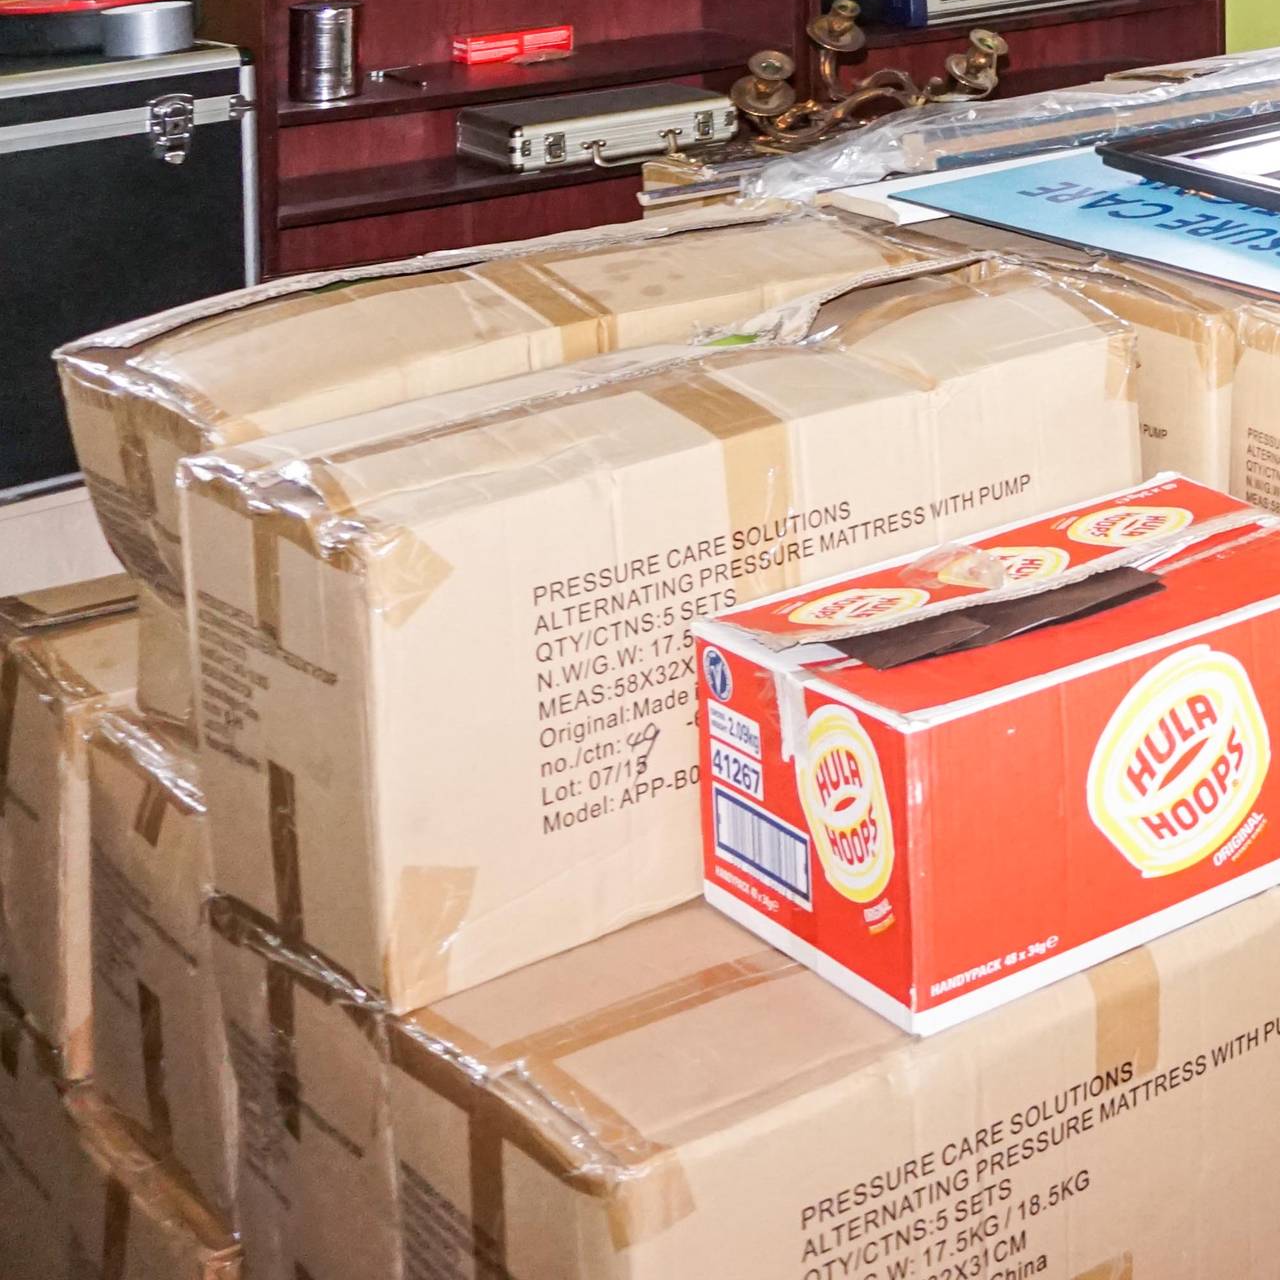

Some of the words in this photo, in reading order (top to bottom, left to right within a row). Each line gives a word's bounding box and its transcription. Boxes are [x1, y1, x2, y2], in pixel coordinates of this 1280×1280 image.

[1017, 182, 1173, 219] CARE
[533, 554, 662, 608] PRESSURE
[666, 536, 727, 572] CARE
[732, 500, 852, 552] SOLUTIONS
[534, 575, 694, 636] ALTERNATING
[700, 537, 814, 585] PRESSURE
[819, 504, 926, 555] MATTRESS
[930, 493, 974, 521] WITH
[978, 473, 1032, 507] PUMP
[535, 608, 676, 663] QTY/CTNS:5
[681, 589, 738, 622] SETS
[537, 645, 643, 692] N.W/G.W:
[652, 629, 694, 657] 17.5
[539, 656, 695, 721] MEAS:58X32X
[540, 689, 689, 748] Original:Made
[1126, 694, 1218, 797] HULA
[543, 796, 614, 834] Model:
[619, 765, 700, 809] APP-B0
[713, 749, 760, 794] 41267
[816, 749, 863, 807] HULA
[1141, 725, 1244, 840] HOOPS
[824, 801, 878, 865] HOOPS
[1212, 811, 1264, 866] ORIGINAL
[930, 958, 1001, 997] HANDYPACK
[800, 1152, 936, 1231] PRESSURE
[941, 1122, 1004, 1168] CARE
[1009, 1061, 1134, 1136] SOLUTIONS
[801, 1169, 970, 1263] ALTERNATING
[975, 1111, 1095, 1184] PRESSURE
[1099, 1055, 1207, 1123] MATTRESS
[1211, 1021, 1260, 1069] WITH
[953, 1177, 1013, 1224] SETS
